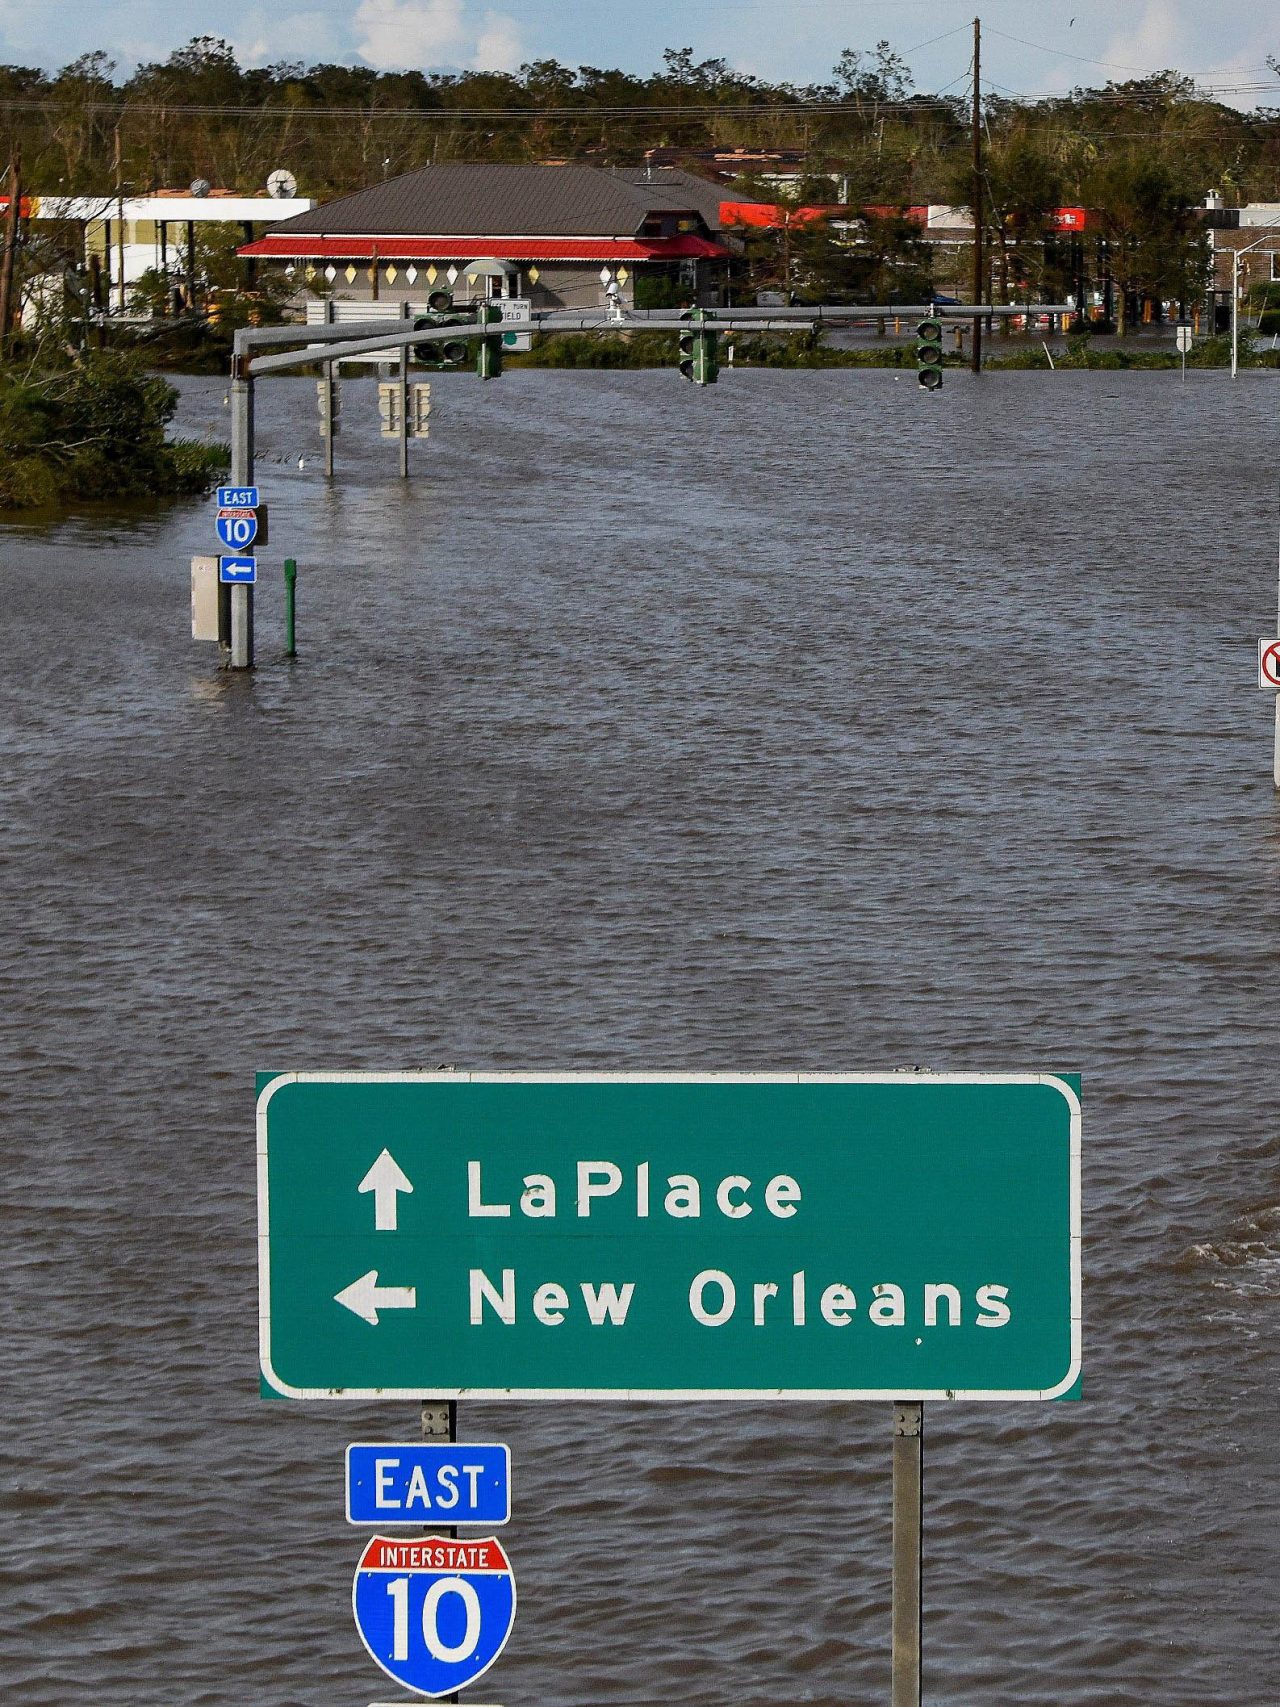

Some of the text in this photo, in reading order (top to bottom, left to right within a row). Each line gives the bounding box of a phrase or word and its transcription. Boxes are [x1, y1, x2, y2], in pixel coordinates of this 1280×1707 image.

[224, 491, 252, 504] EAST
[225, 519, 250, 542] 10
[467, 1160, 803, 1220] LaPlace
[468, 1268, 1013, 1328] New Orleans
[374, 1459, 485, 1509] EAST
[379, 1545, 490, 1570] INTERSTATE
[385, 1577, 483, 1664] 10
